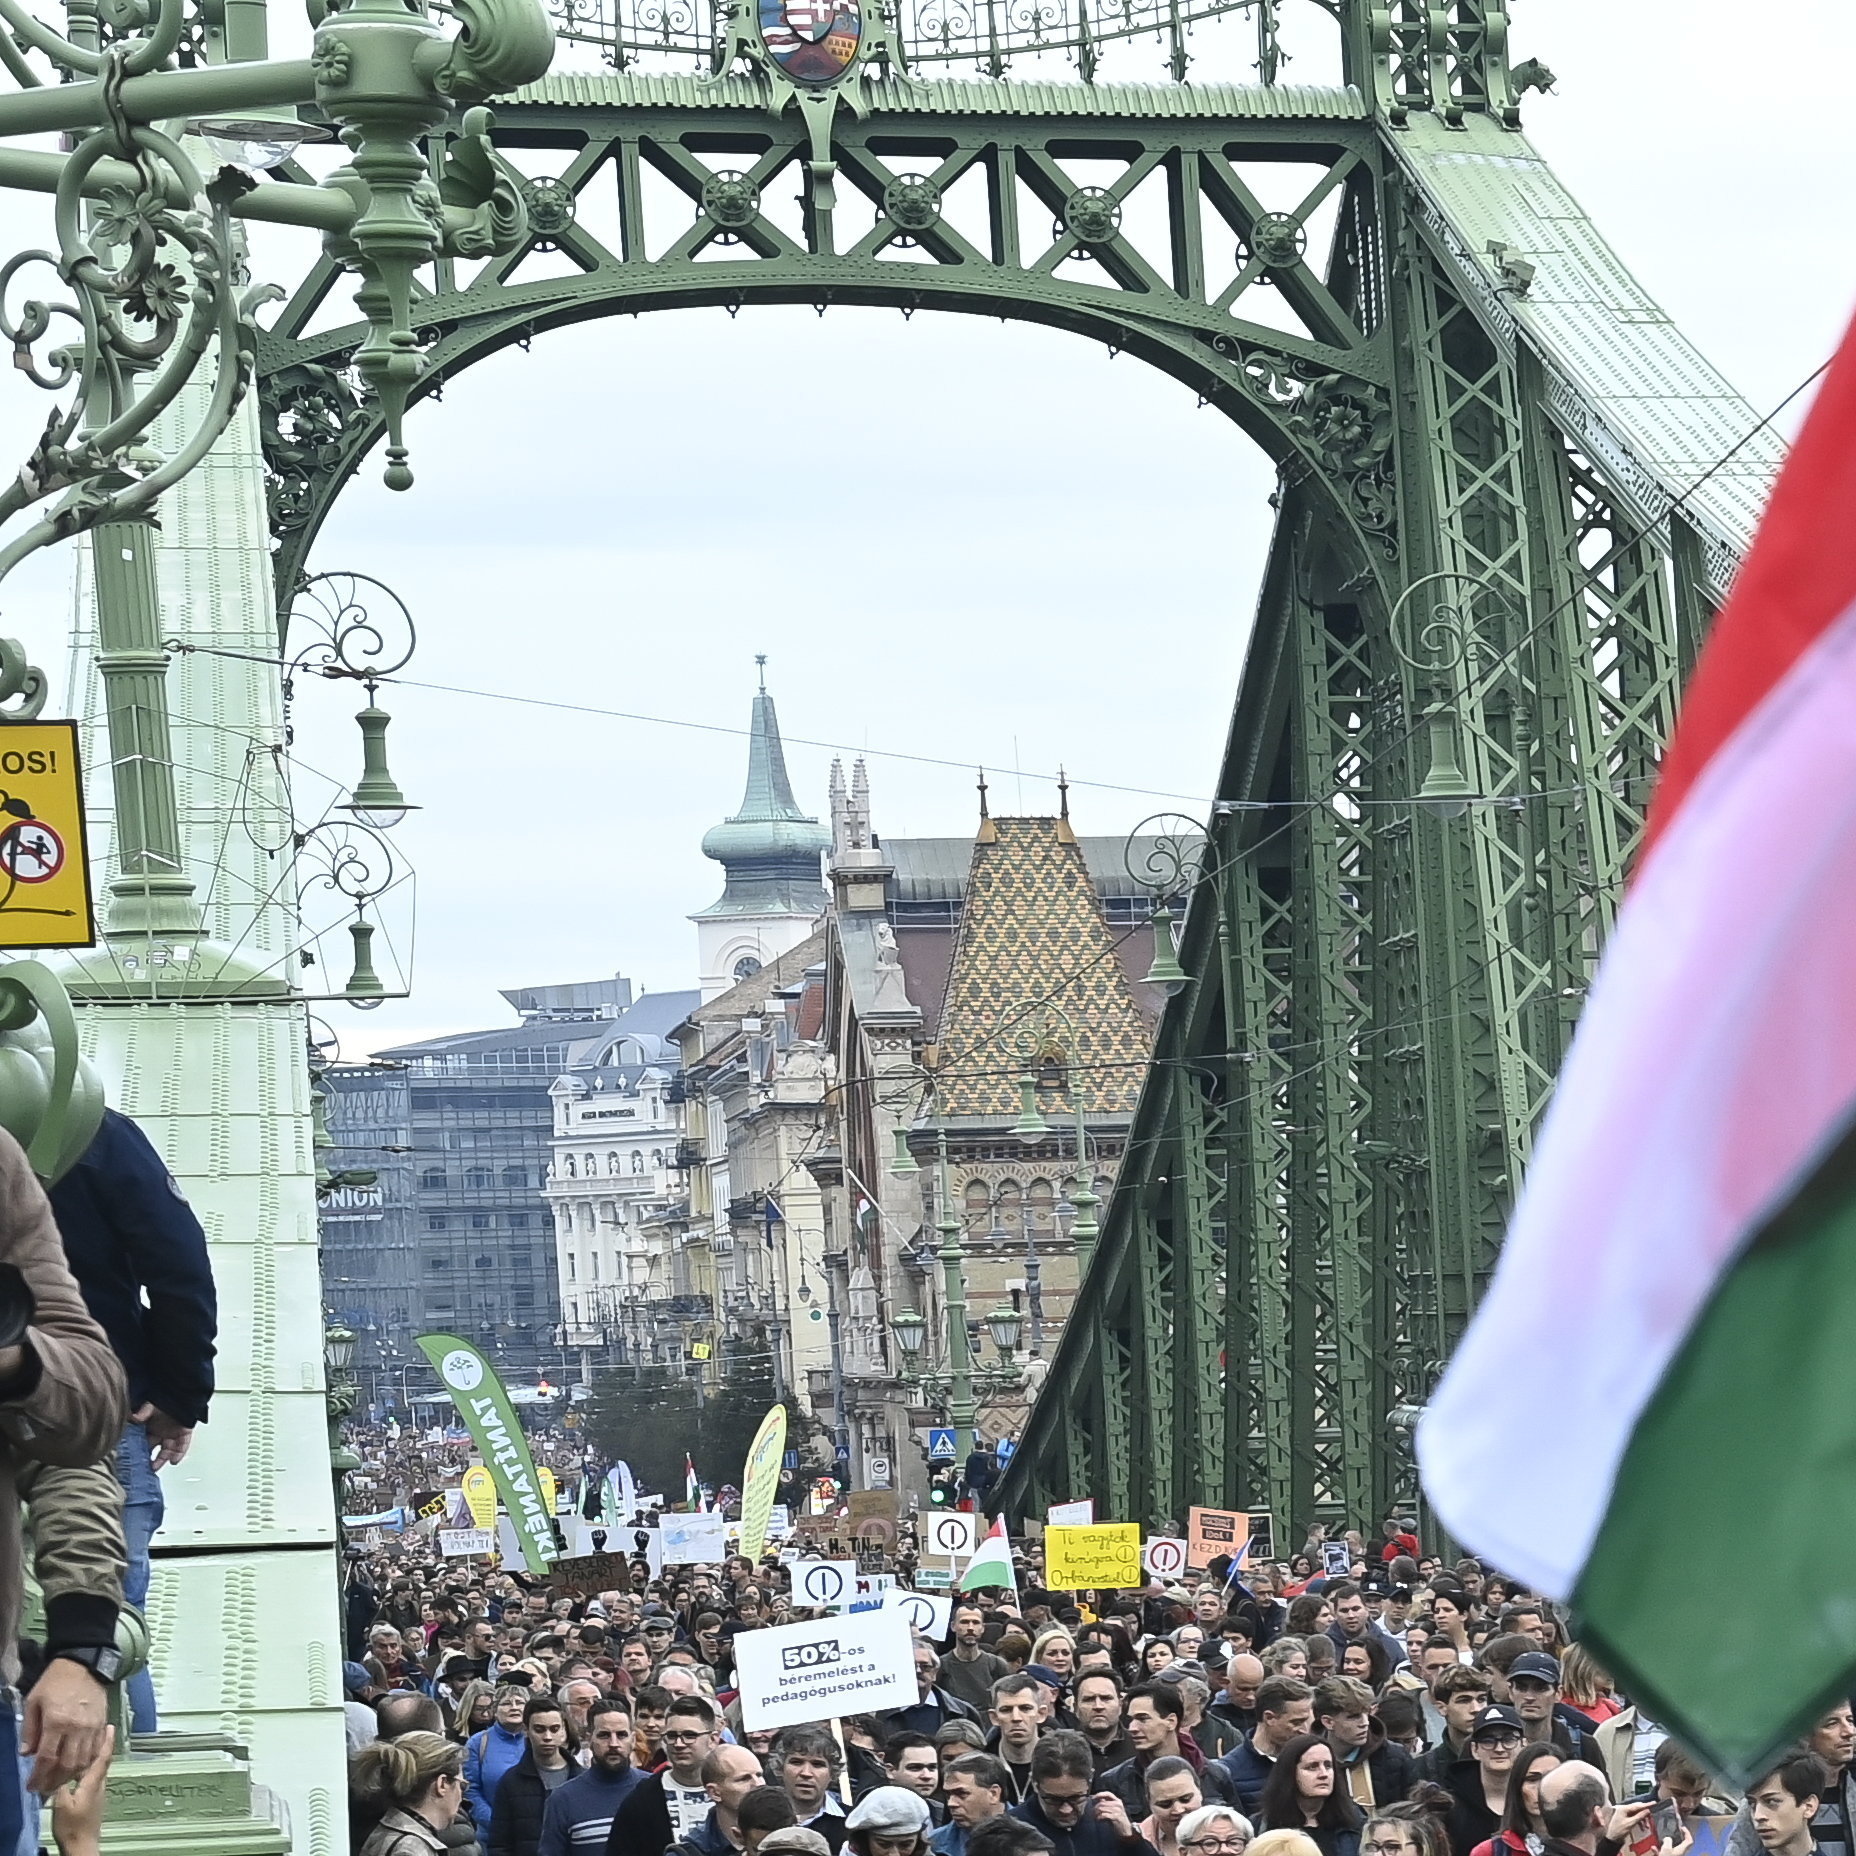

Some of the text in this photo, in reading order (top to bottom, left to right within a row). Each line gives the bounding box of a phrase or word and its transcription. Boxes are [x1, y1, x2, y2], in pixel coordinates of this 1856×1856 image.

[0, 750, 57, 775] OS!
[783, 1642, 866, 1668] 50%-os
[778, 1662, 876, 1687] béremelést a
[761, 1673, 896, 1708] pedagógusoknak!
